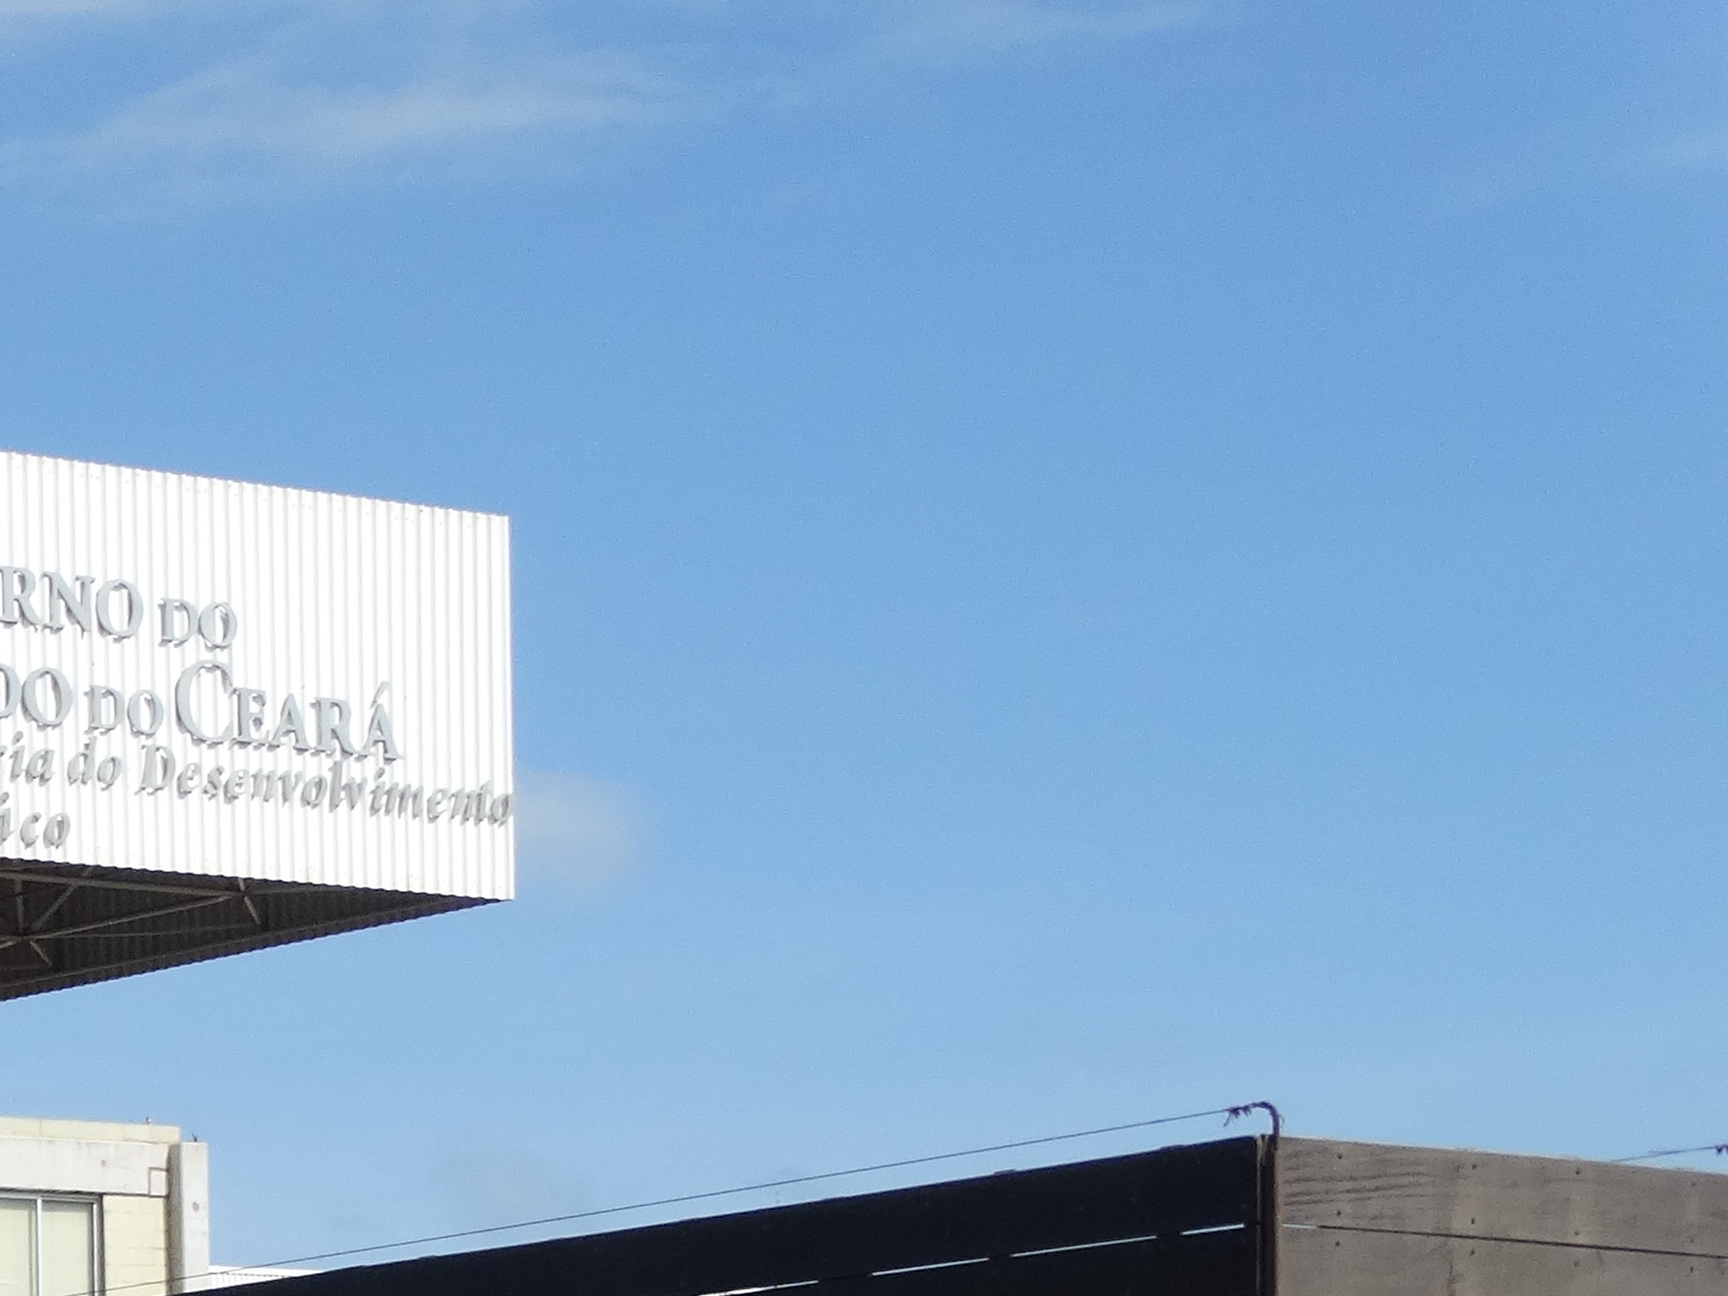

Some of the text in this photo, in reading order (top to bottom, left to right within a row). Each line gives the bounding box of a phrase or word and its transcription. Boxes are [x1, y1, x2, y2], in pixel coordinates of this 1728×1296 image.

[175, 659, 404, 763] CEARÁ
[67, 736, 122, 791] do
[135, 744, 512, 827] Desenvolvimento
